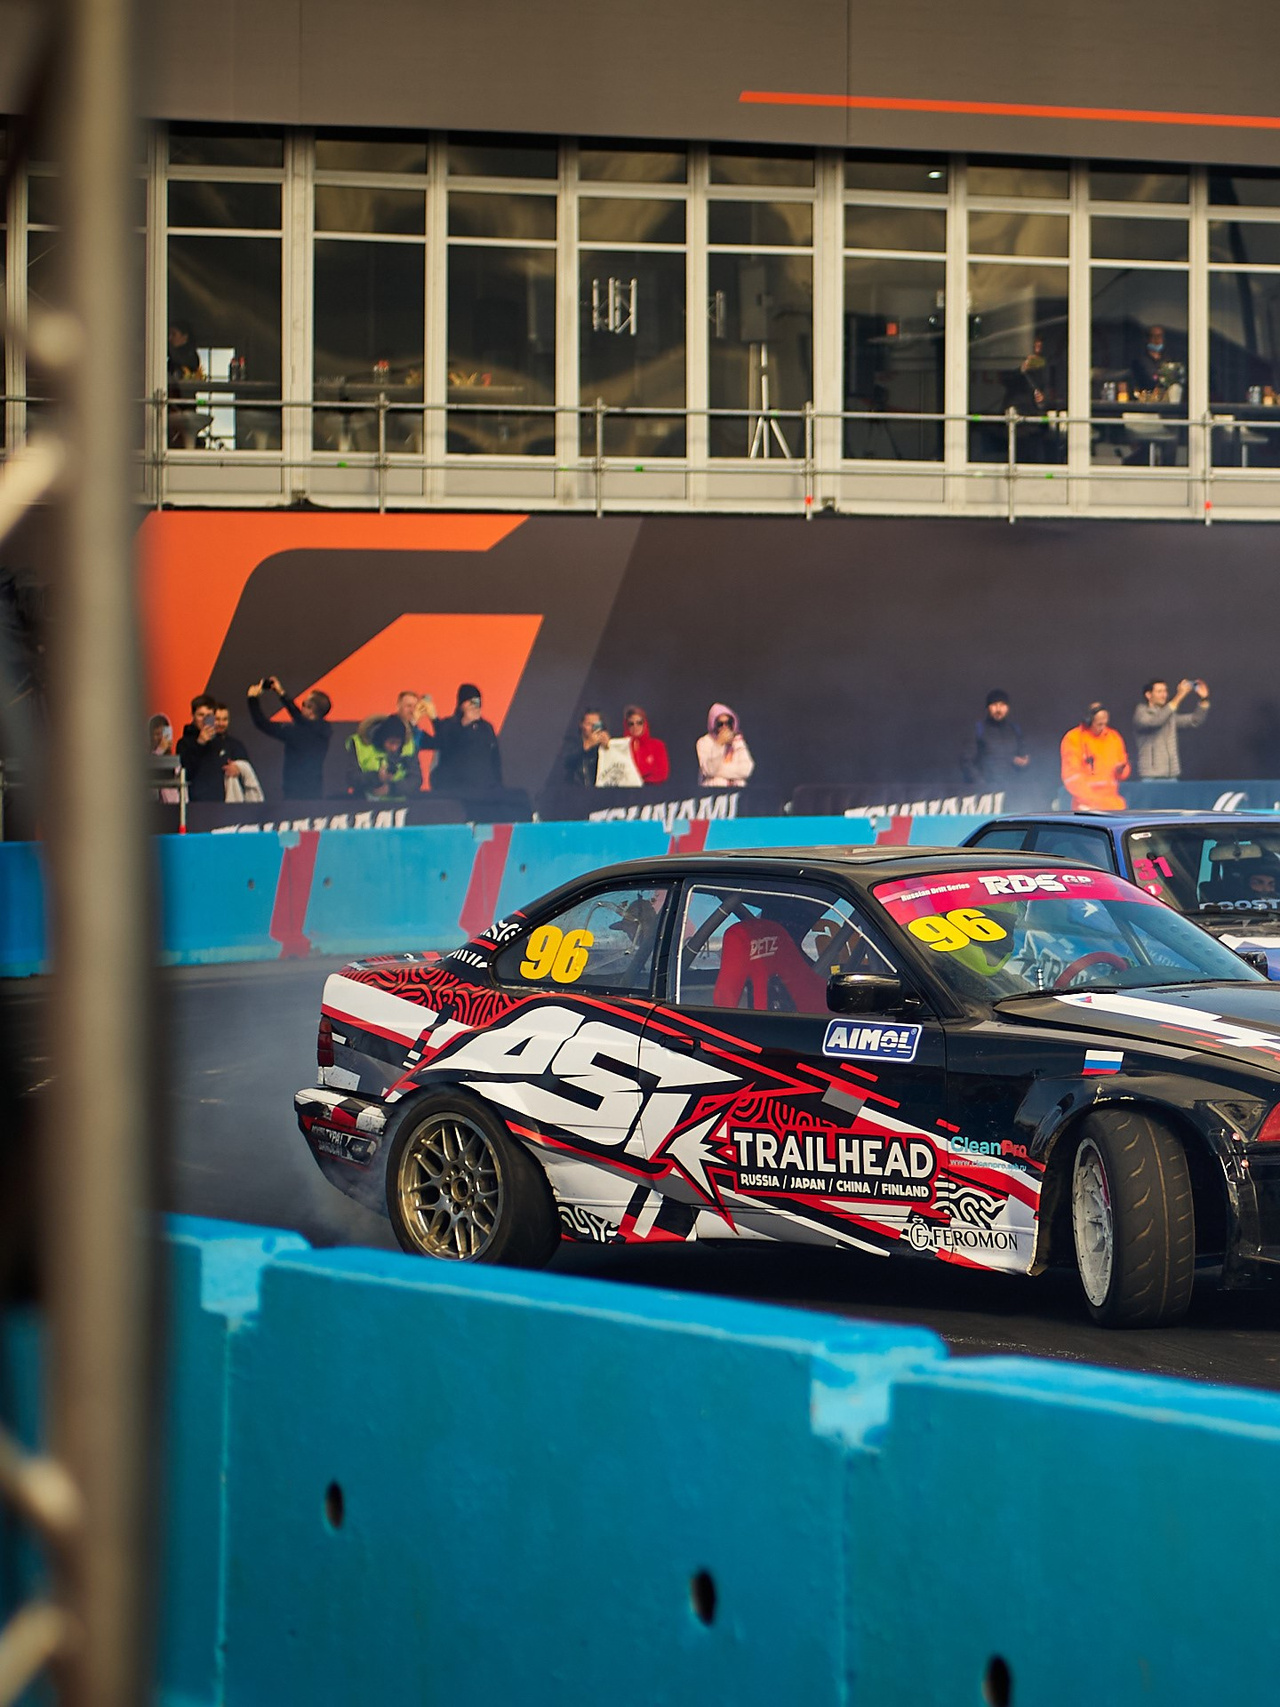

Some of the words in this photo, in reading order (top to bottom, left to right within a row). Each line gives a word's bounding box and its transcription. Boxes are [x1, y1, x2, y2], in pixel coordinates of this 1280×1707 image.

[1133, 856, 1174, 881] 31
[901, 890, 930, 902] Russian
[930, 886, 947, 894] Drift
[946, 883, 970, 891] Series
[978, 874, 1067, 896] RDS
[908, 908, 1007, 952] 96
[519, 925, 594, 983] 96
[827, 1026, 912, 1054] AIMOL
[734, 1132, 934, 1179] TRAILHEAD
[950, 1136, 1027, 1158] CleanPro
[740, 1173, 780, 1188] RUSSIA
[791, 1176, 826, 1191] JAPAN
[836, 1181, 871, 1194] CHINA
[881, 1183, 930, 1198] FINLAND
[933, 1228, 1018, 1251] FEROMON
